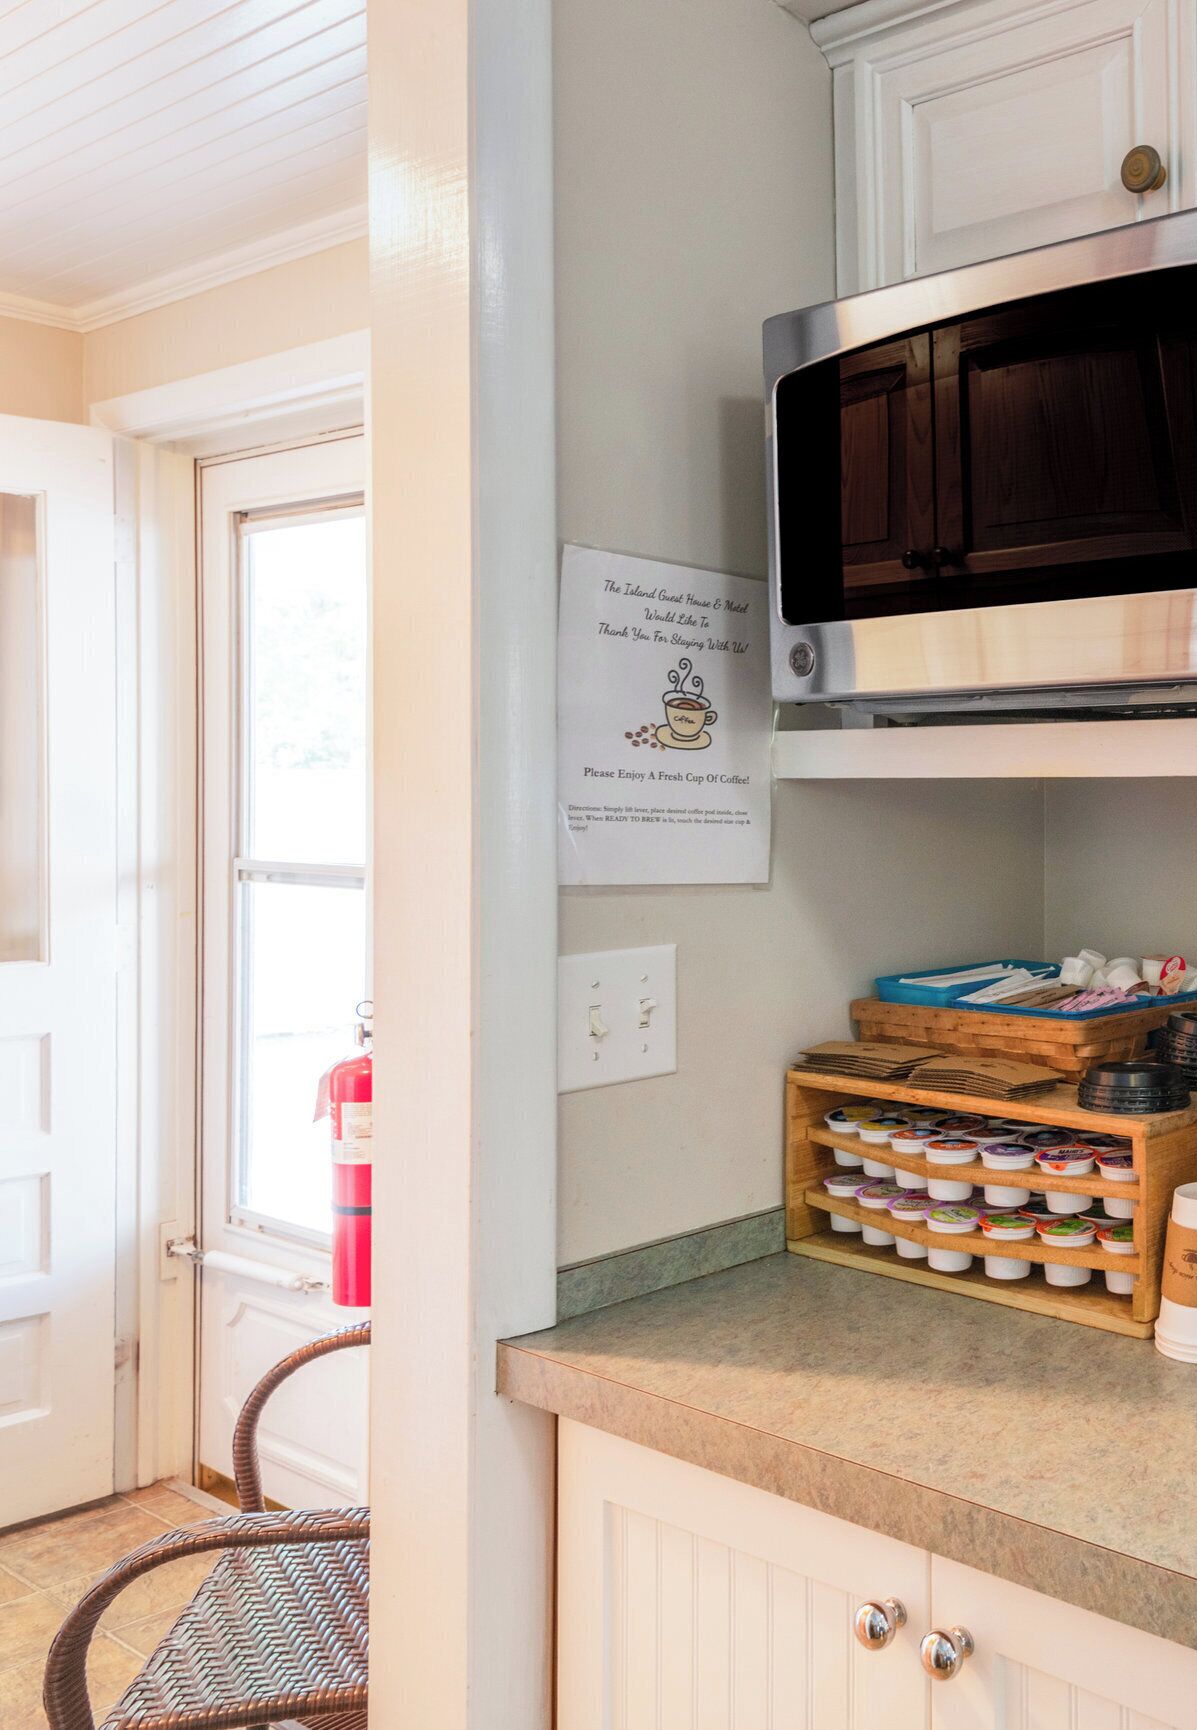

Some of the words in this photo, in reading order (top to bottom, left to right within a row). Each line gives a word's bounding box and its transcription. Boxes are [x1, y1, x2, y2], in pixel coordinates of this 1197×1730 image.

[605, 580, 621, 594] The
[624, 583, 657, 600] Island
[659, 589, 684, 604] Guest
[686, 593, 711, 608] House
[713, 599, 722, 610] &
[724, 600, 749, 614] Motel
[645, 608, 675, 623] Would
[677, 613, 697, 627] Like
[700, 616, 709, 628] To
[598, 623, 629, 638] Thank
[632, 627, 650, 641] You
[654, 631, 668, 643] For
[671, 633, 704, 651] Staying
[708, 638, 729, 651] With
[733, 642, 749, 654] Us!
[584, 768, 615, 778] Please
[618, 770, 645, 782] Enjoy
[648, 772, 656, 780] A
[658, 772, 683, 781] Fresh
[686, 773, 704, 785] Cup
[707, 774, 718, 783] Of
[720, 775, 750, 785] Coffee!
